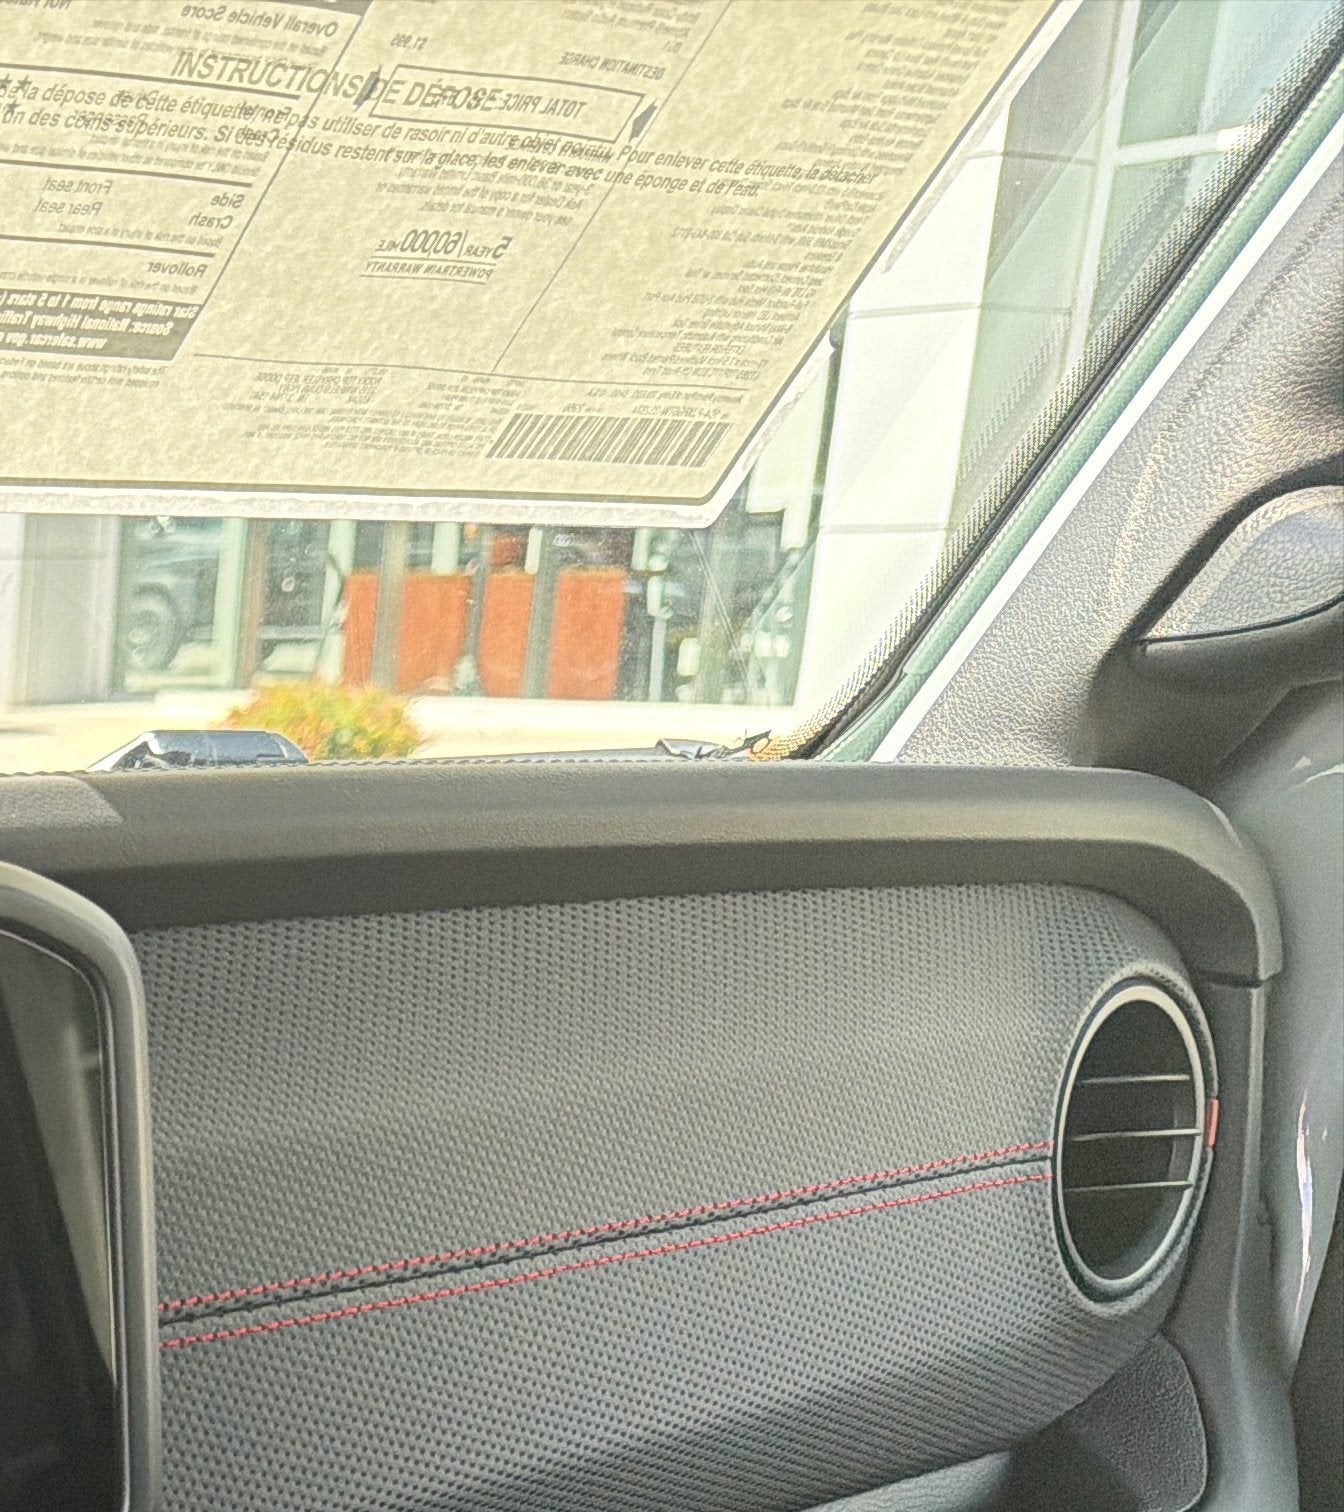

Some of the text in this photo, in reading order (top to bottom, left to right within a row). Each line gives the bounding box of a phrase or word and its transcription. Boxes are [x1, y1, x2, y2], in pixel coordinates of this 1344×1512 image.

[171, 49, 364, 98] INSTRUCTIONS
[28, 108, 62, 128] des
[213, 124, 235, 143] Si
[603, 166, 635, 187] une
[637, 170, 687, 194] éponge
[688, 176, 704, 194] et
[705, 177, 723, 196] de
[42, 84, 106, 107] dépose
[322, 114, 376, 137] utiliser
[381, 121, 402, 140] de
[404, 124, 451, 143] rasoir
[617, 144, 653, 166] Pour
[654, 150, 709, 171] enlever
[709, 158, 745, 176] cette
